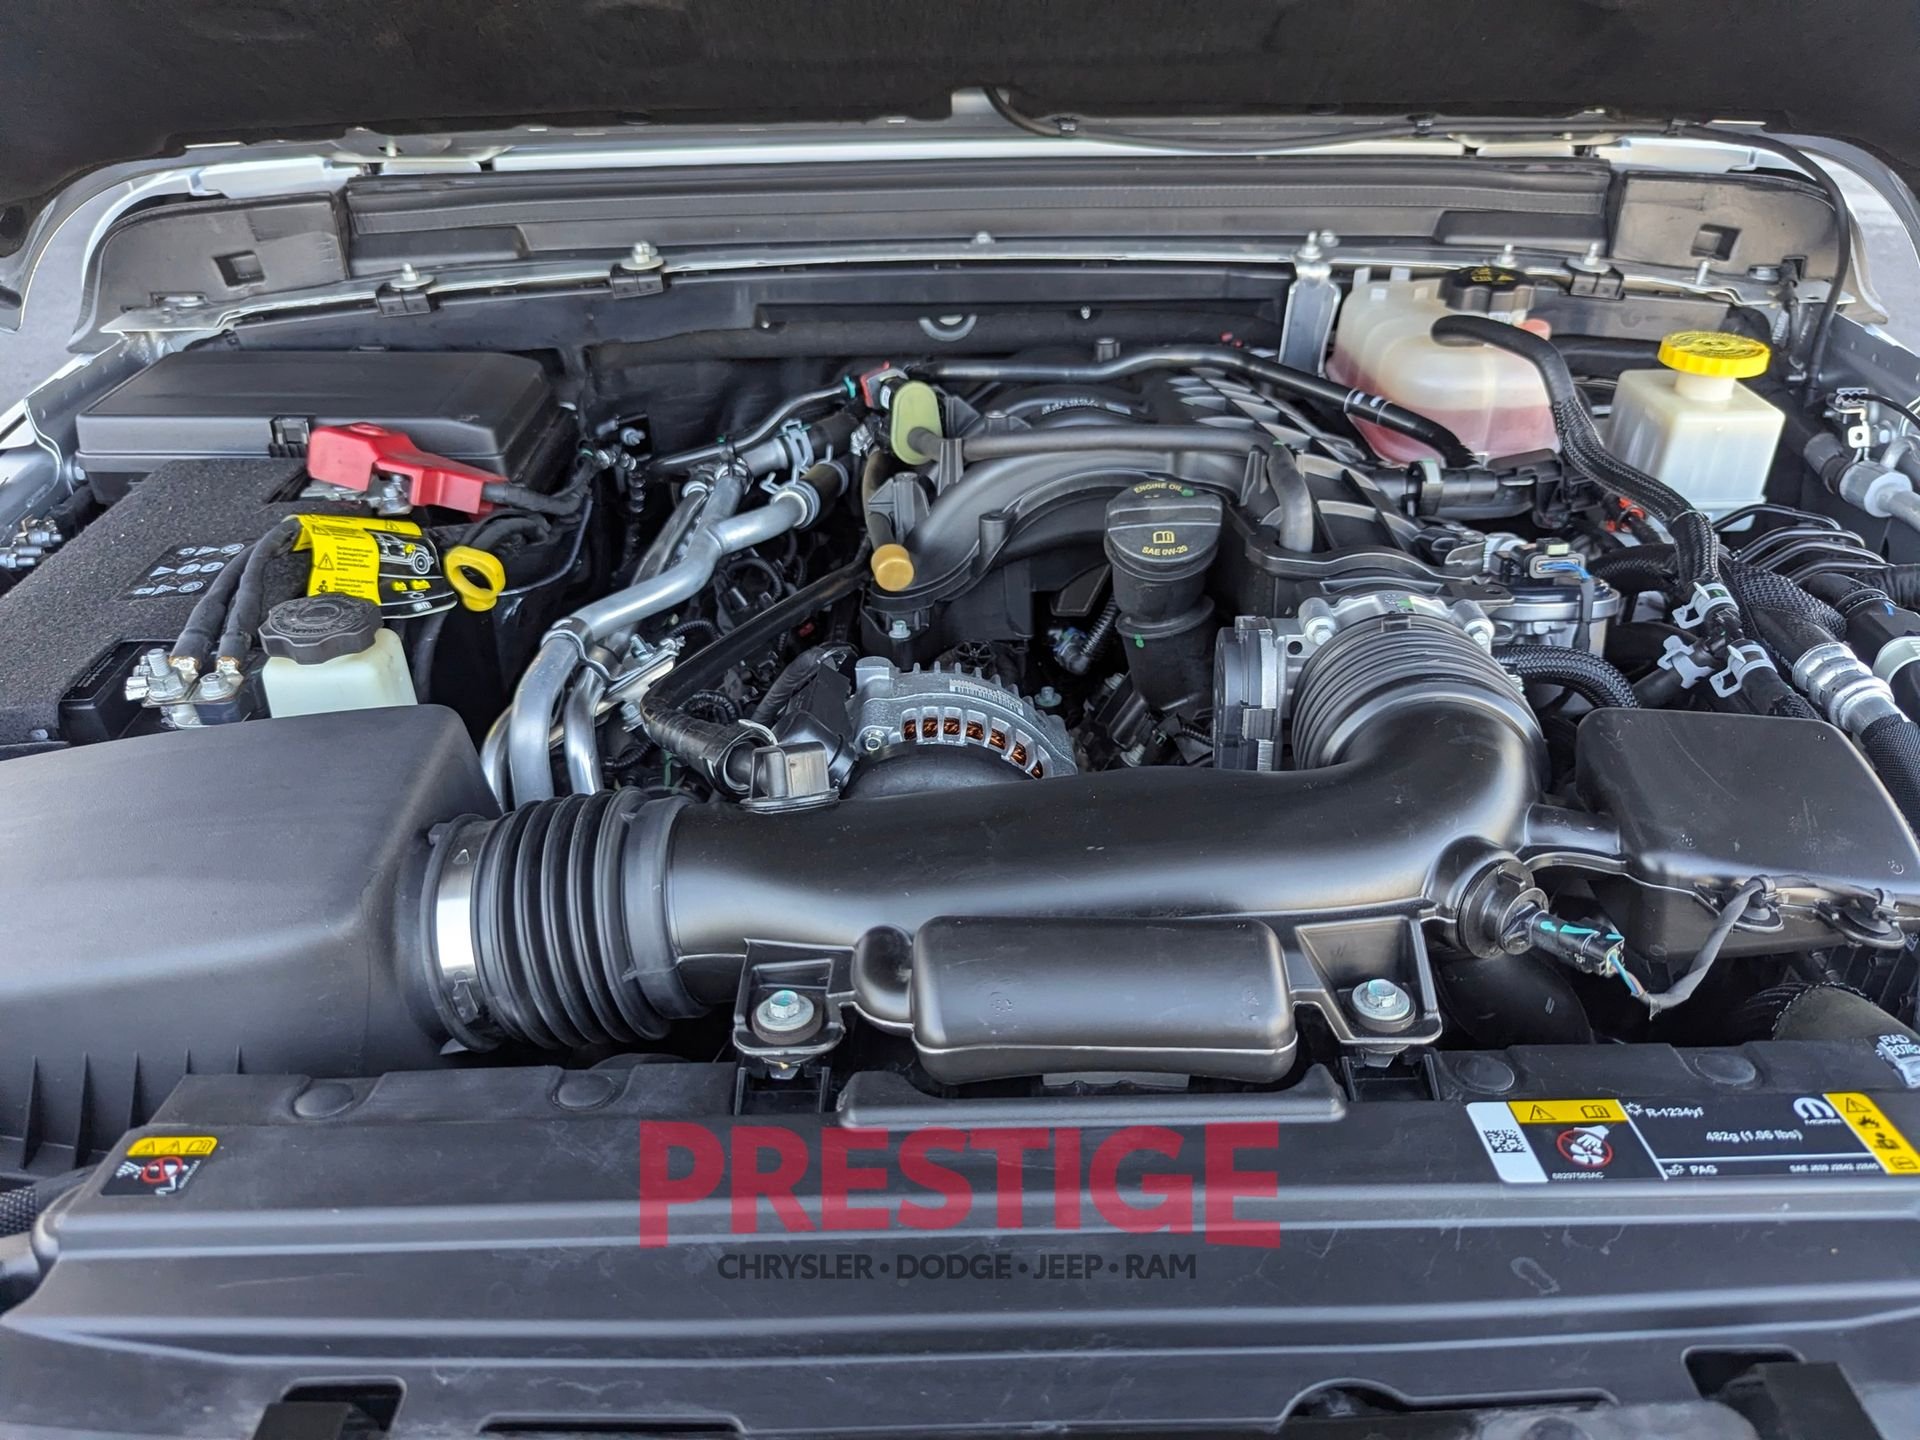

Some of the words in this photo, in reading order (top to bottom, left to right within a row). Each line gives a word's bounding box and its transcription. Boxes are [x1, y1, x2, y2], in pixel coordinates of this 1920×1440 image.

[1133, 482, 1167, 493] ENGINE
[1168, 483, 1184, 492] OIL
[1142, 545, 1161, 556] SAE
[1878, 1034, 1910, 1046] RAD
